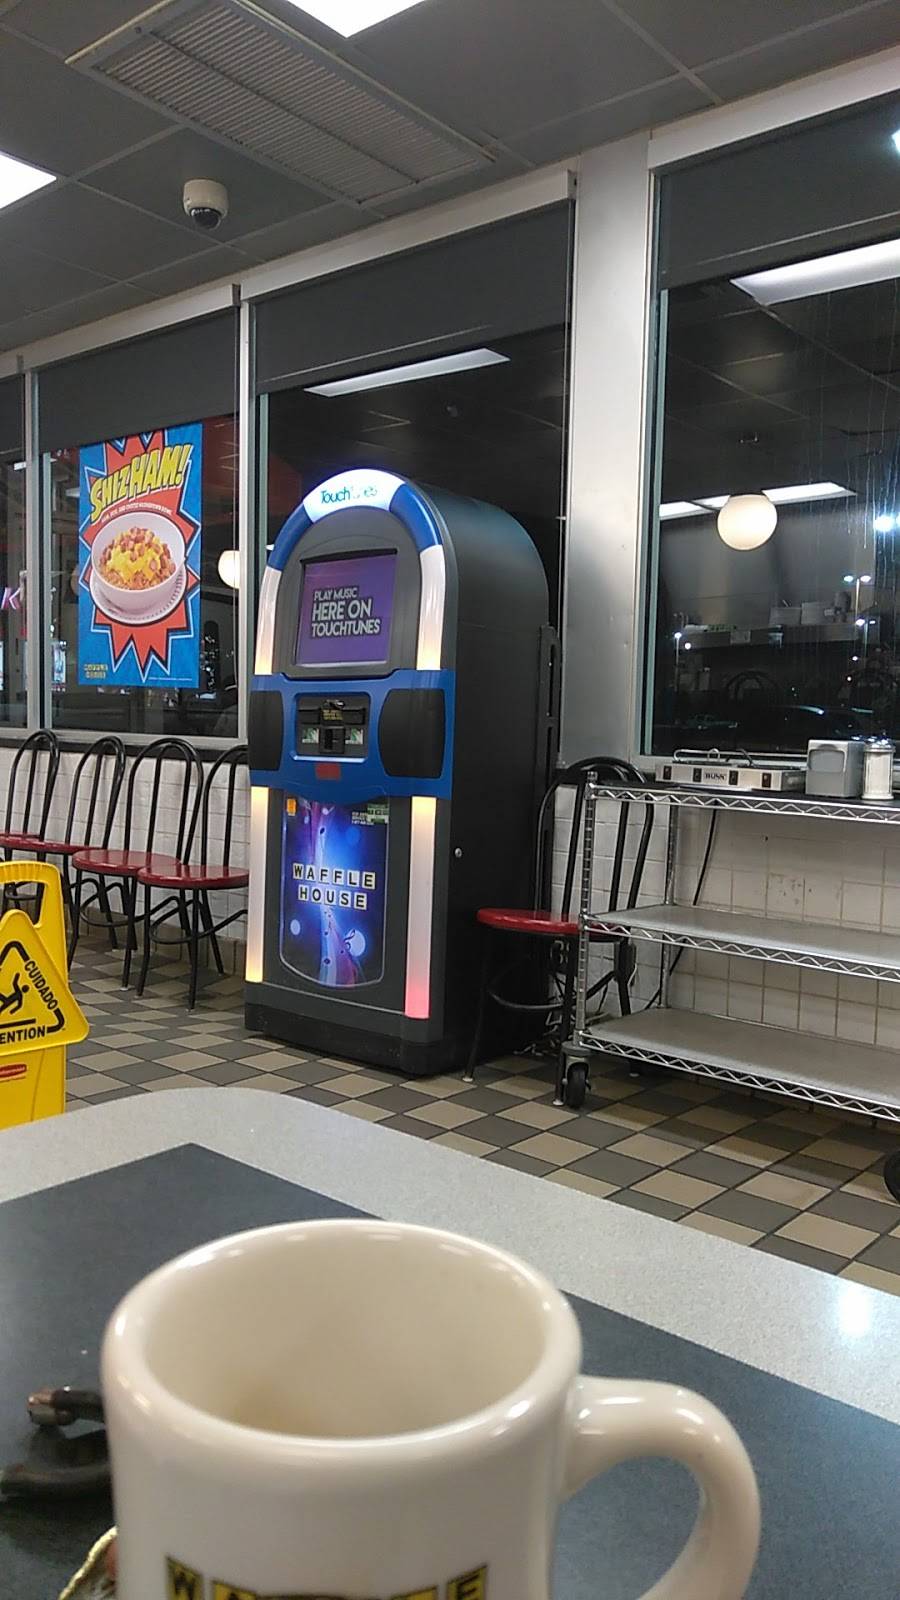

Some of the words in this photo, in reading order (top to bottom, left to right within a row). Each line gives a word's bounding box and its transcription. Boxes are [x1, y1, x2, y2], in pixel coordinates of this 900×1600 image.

[90, 444, 192, 522] SHIZHAM!
[314, 590, 333, 601] PLAY
[333, 588, 357, 600] MUSIC
[312, 601, 345, 622] HERE
[347, 598, 372, 618] ON
[312, 619, 380, 637] TOUCHTUNES
[293, 864, 374, 888] WAFFLE
[299, 886, 366, 909] HOUSE
[24, 960, 59, 1010] CUIDADO
